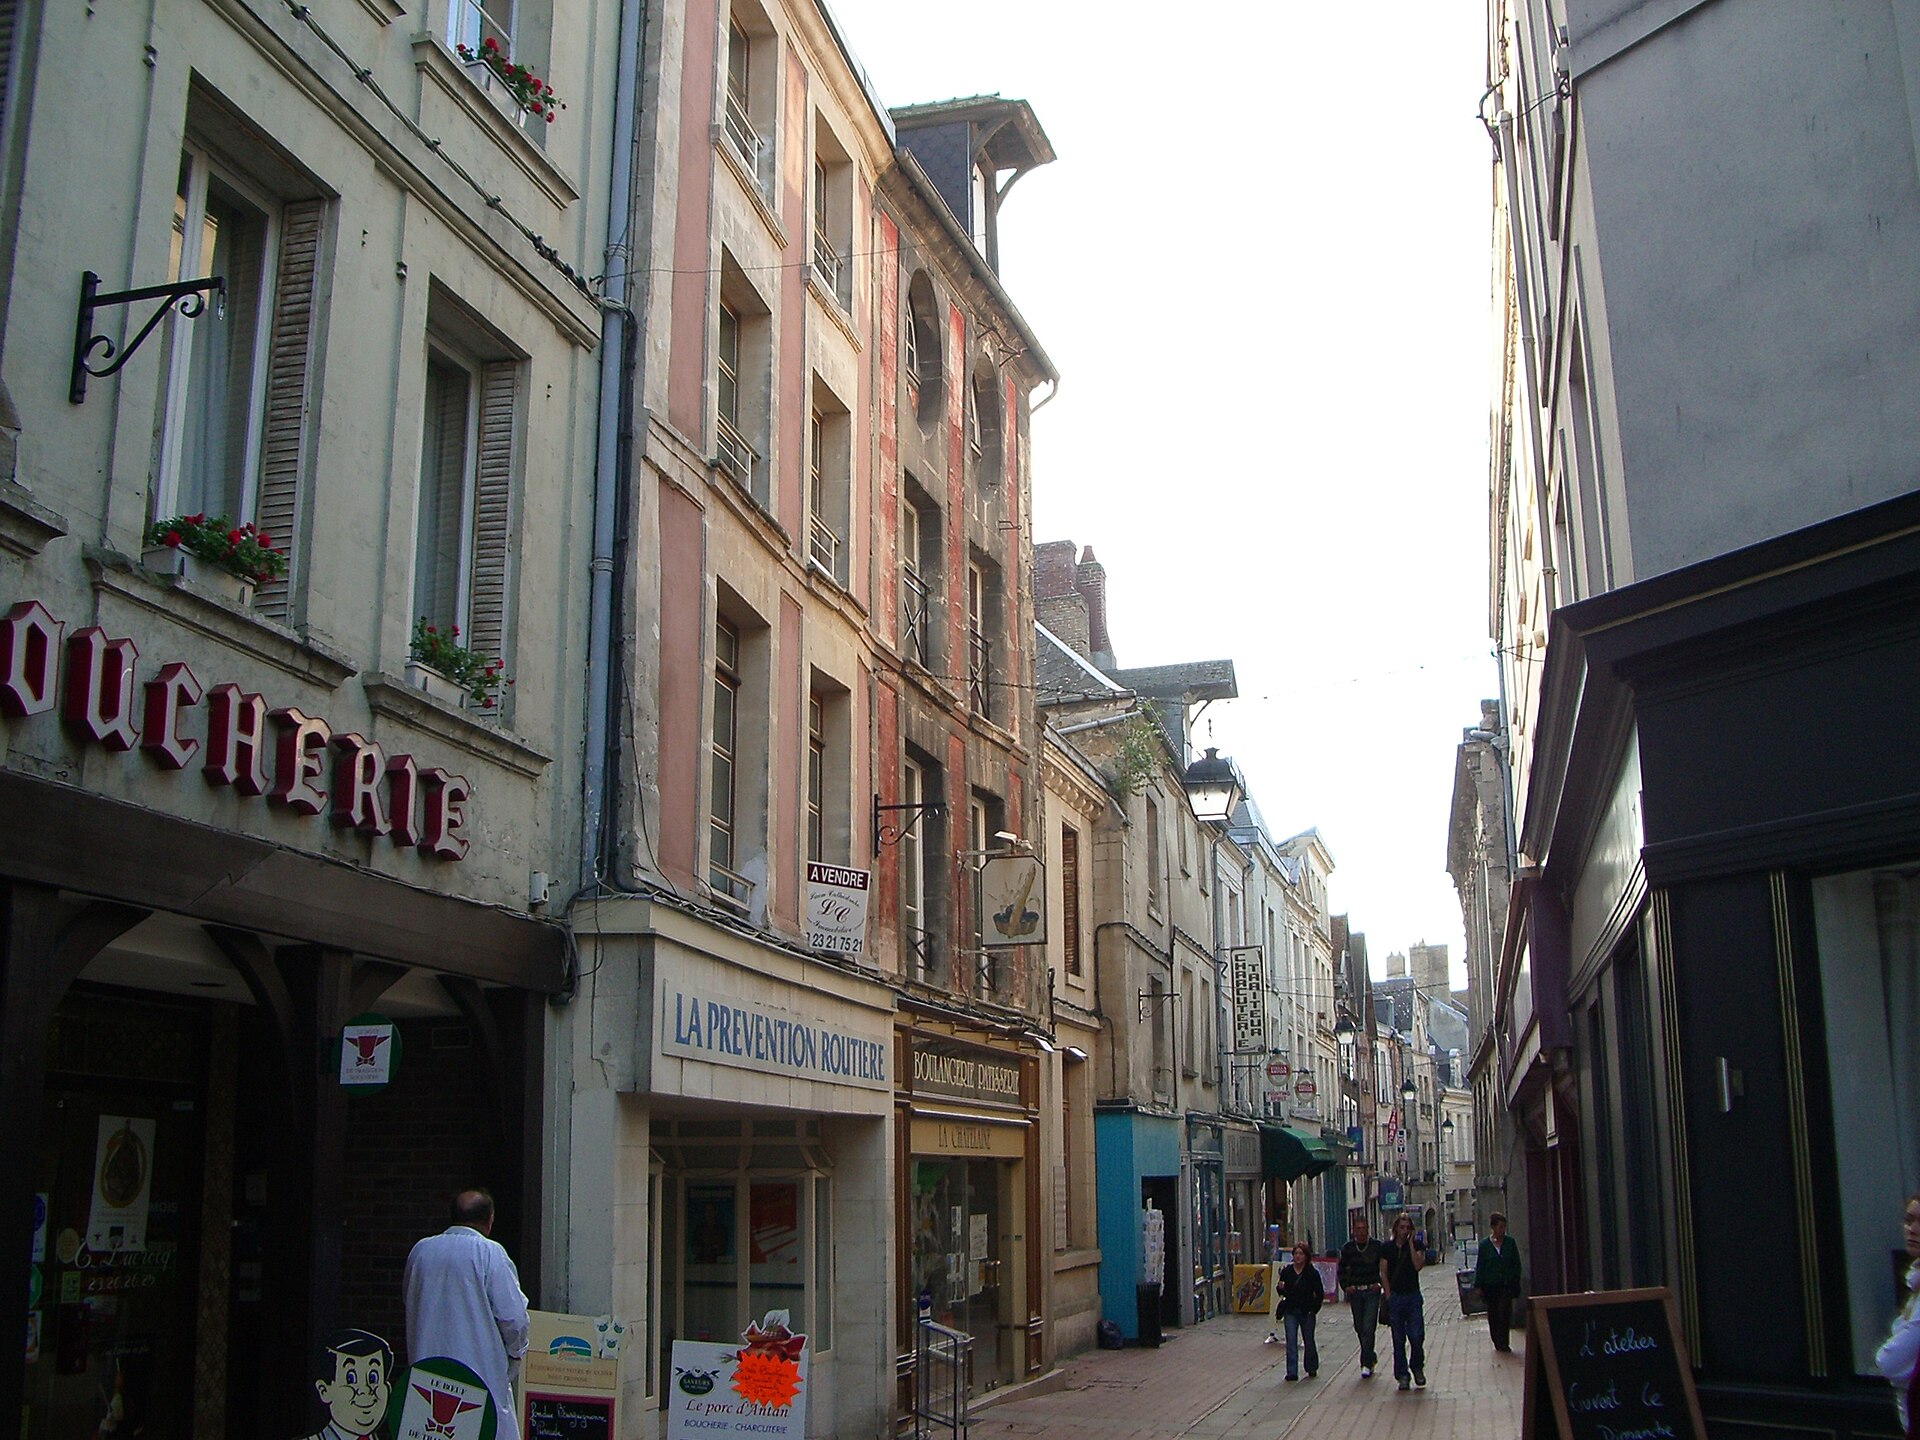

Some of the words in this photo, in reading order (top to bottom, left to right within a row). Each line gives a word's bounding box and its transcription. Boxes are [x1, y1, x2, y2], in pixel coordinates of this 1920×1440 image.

[810, 866, 819, 880] A
[821, 867, 864, 888] VENDRE
[812, 932, 824, 947] 23
[826, 934, 837, 949] 21
[840, 936, 851, 951] 75
[852, 938, 863, 952] 21
[1234, 953, 1248, 1048] CHARCUTERIE
[1248, 964, 1262, 1036] TRAITEUR
[675, 992, 703, 1048] LA
[707, 1001, 816, 1069] PREVENTION
[821, 1030, 886, 1081] ROUTIERE
[914, 1051, 974, 1088] BOULANGERIE
[978, 1063, 1019, 1095] PATISSERIE
[938, 1124, 948, 1147] LA
[430, 1378, 440, 1387] LE
[686, 1399, 703, 1412] Le
[705, 1403, 733, 1417] porc
[736, 1400, 789, 1418] d'Antan
[684, 1419, 728, 1431] BOUCHERIE
[735, 1422, 788, 1435] CHARCUTERIE
